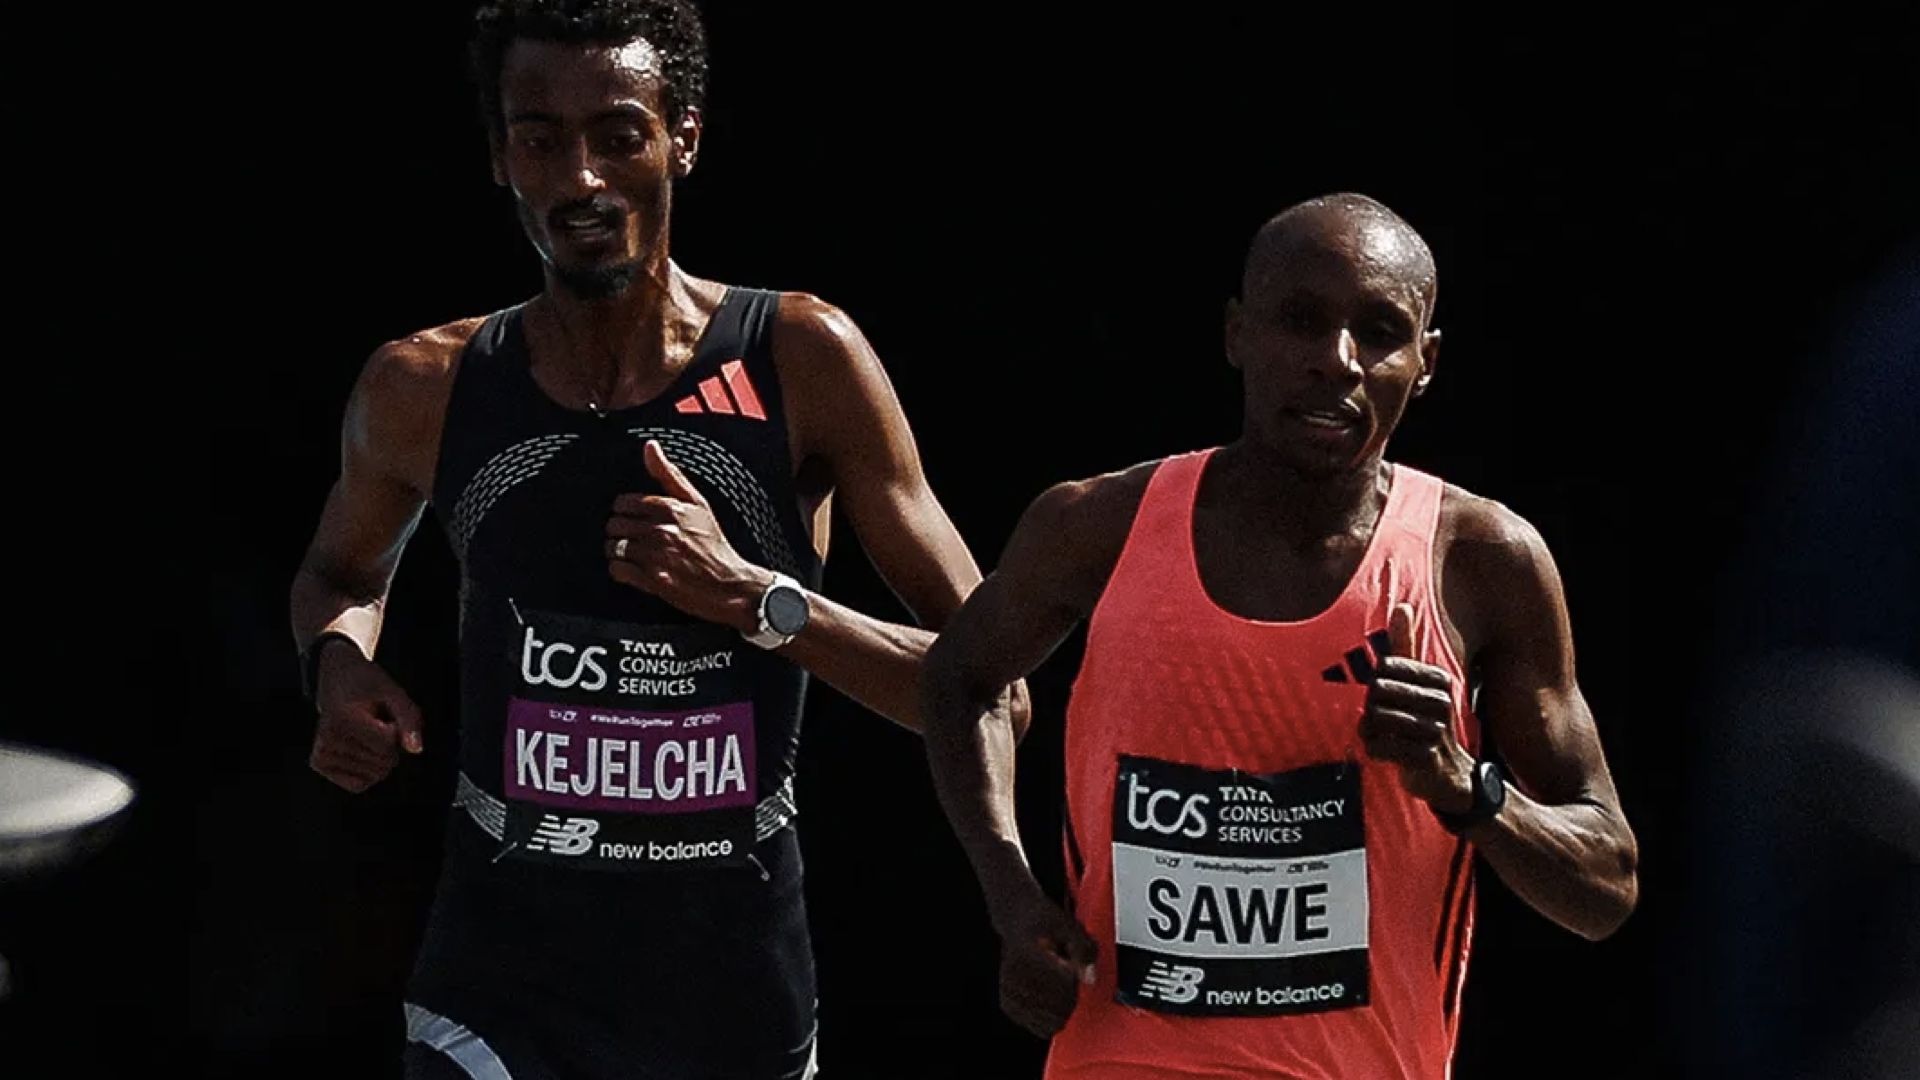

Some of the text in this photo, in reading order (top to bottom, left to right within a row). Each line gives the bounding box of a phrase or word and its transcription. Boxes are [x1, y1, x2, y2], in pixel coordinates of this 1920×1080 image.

[522, 626, 608, 691] tcs
[619, 639, 676, 657] TATA
[617, 677, 697, 696] SERVICES
[516, 728, 747, 800] KEJELCHA
[1128, 773, 1210, 838] tcs
[1219, 786, 1274, 804] TATA
[1219, 799, 1345, 823] CONSULTANCY
[1218, 826, 1302, 844] SERVICES
[600, 842, 644, 859] new
[648, 840, 733, 860] balance
[1148, 878, 1329, 945] SAWE
[1206, 989, 1252, 1005] new
[1256, 983, 1345, 1004] balance
